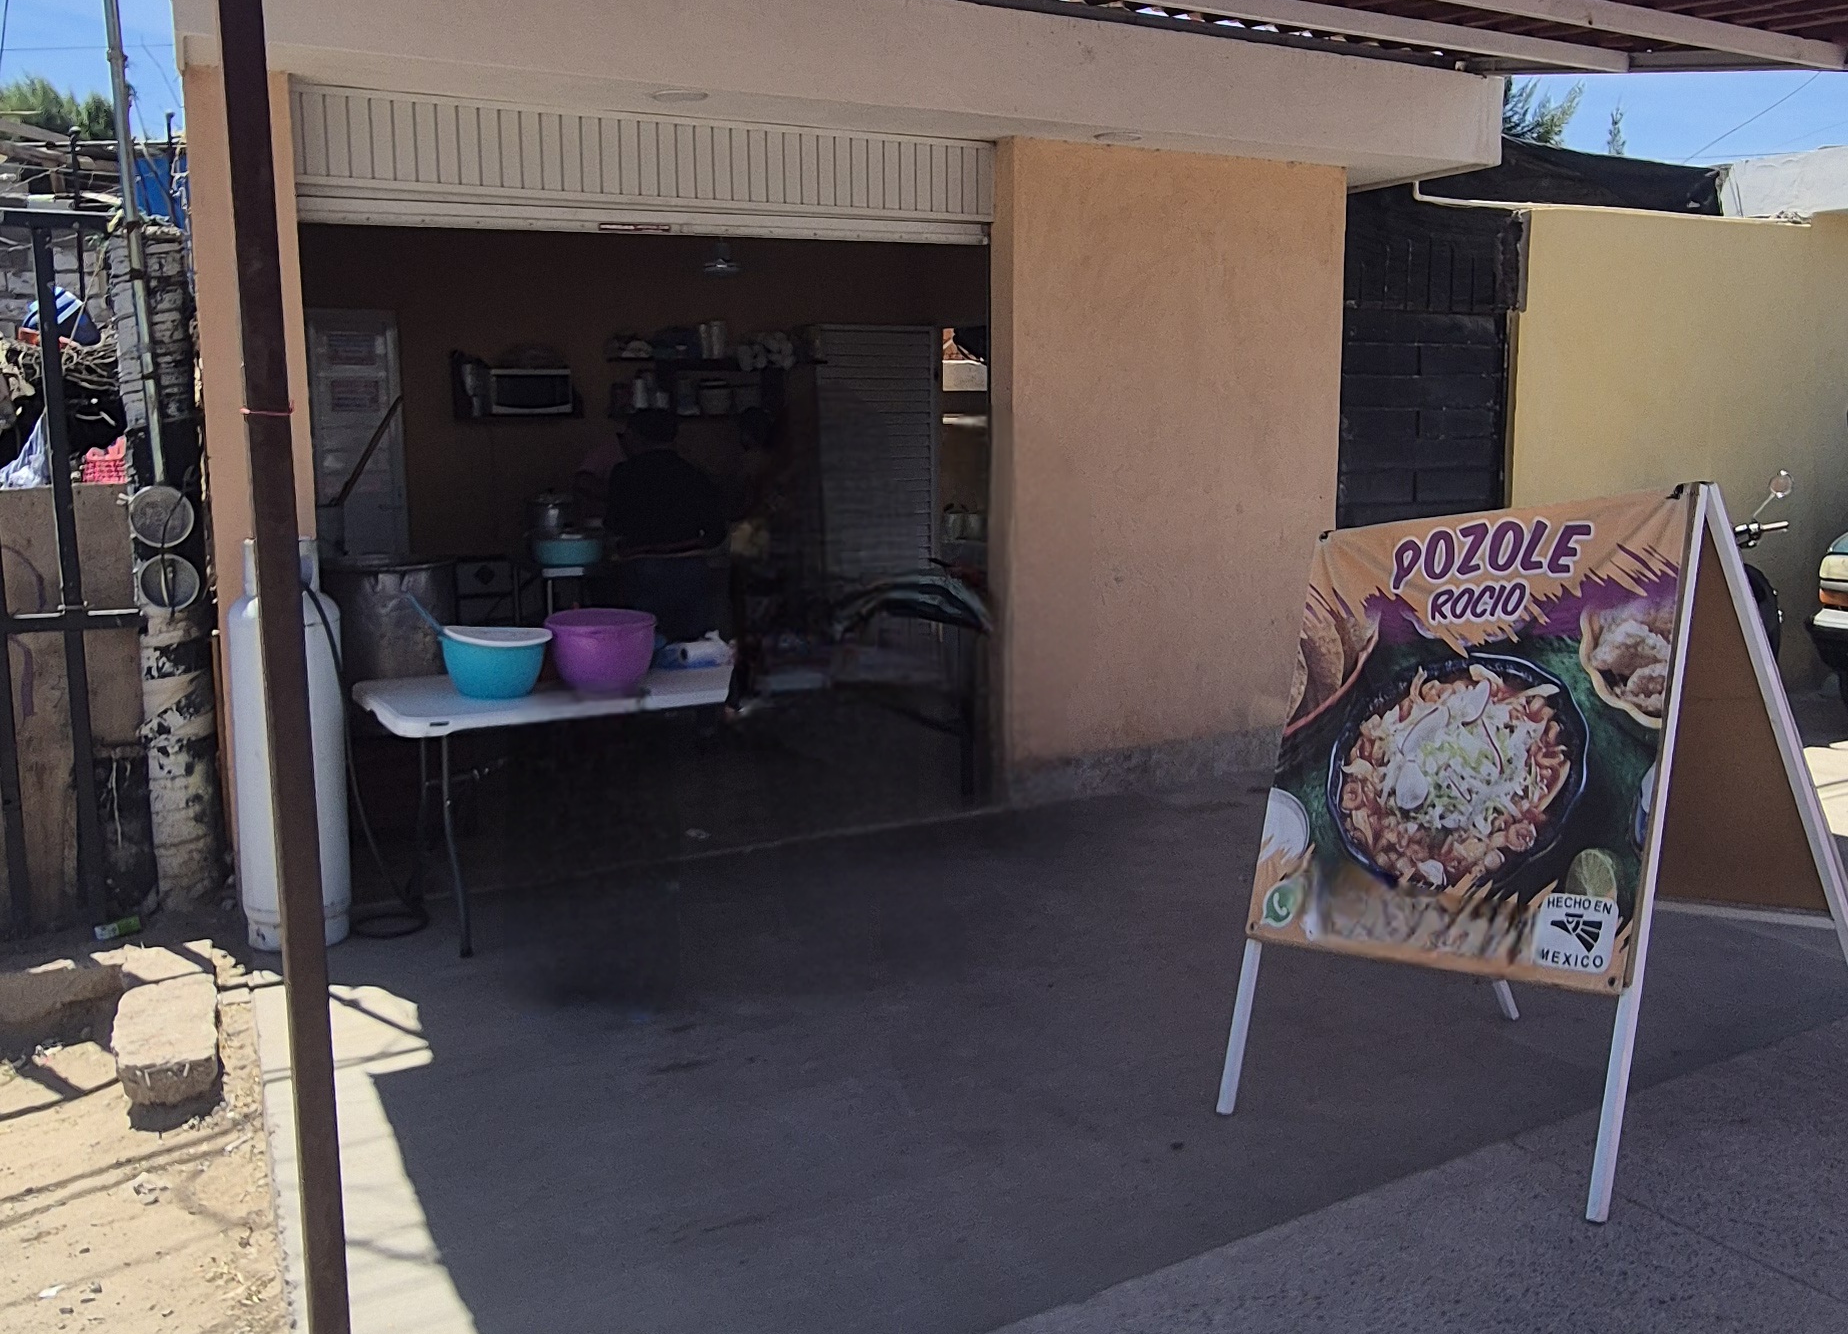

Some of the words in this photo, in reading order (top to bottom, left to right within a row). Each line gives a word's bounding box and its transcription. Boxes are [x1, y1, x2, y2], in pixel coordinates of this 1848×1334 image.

[1392, 519, 1592, 590] POZOLE
[1430, 581, 1527, 622] ROCIO
[1547, 896, 1592, 910] HECHO
[1593, 899, 1613, 915] EN
[1540, 948, 1604, 968] MEXICO
